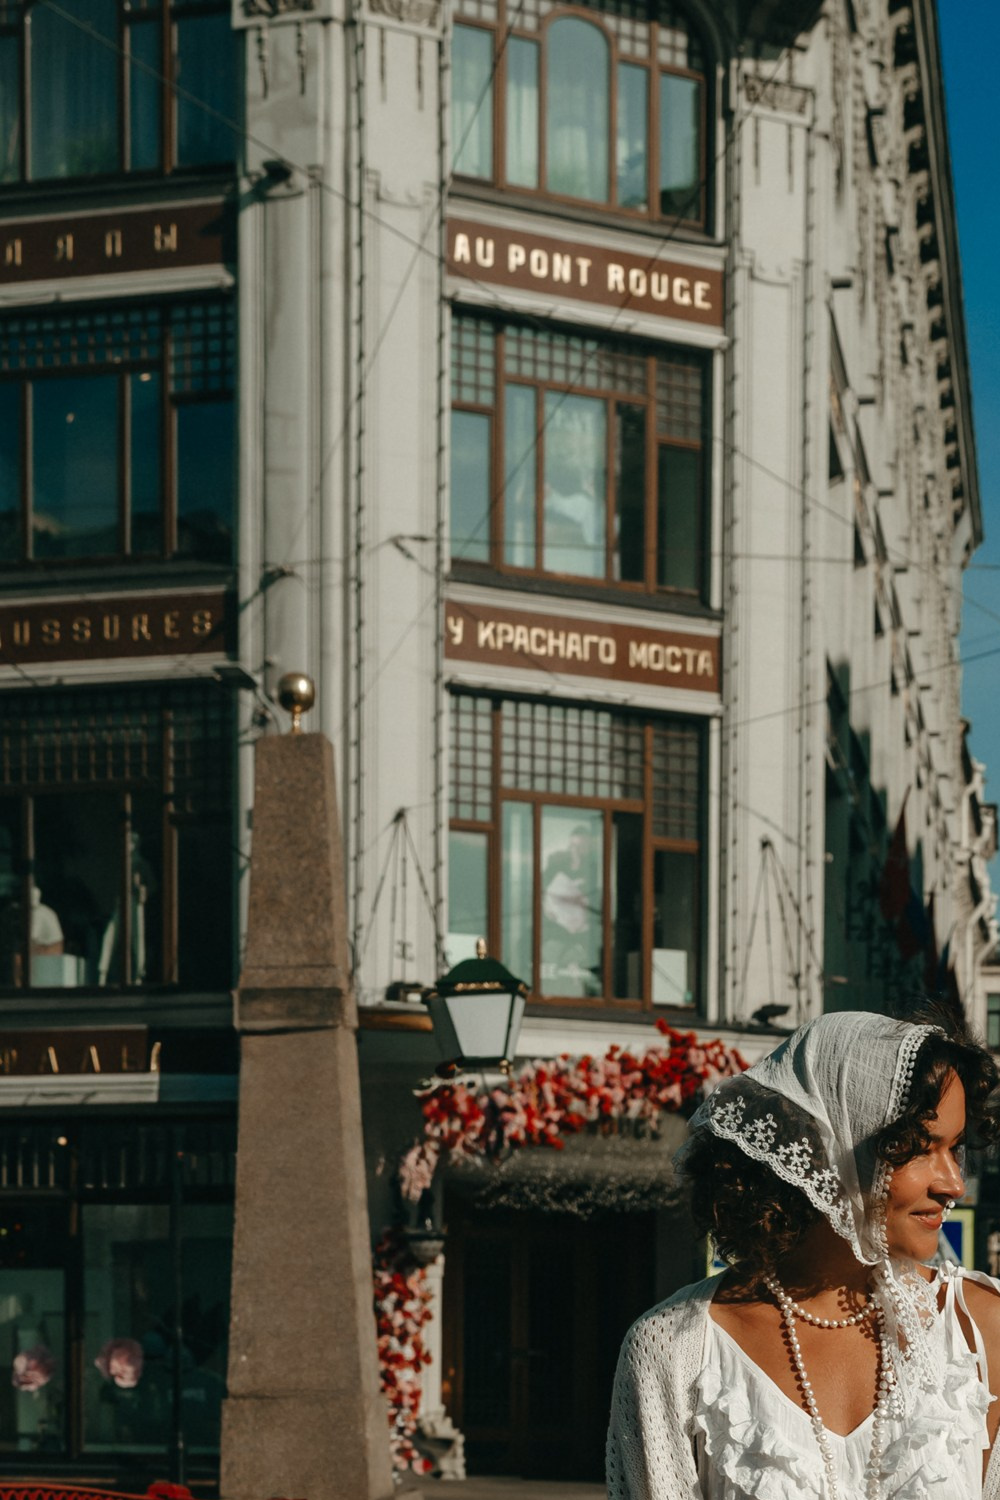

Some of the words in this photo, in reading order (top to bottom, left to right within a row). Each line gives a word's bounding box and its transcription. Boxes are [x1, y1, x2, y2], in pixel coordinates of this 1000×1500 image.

[454, 233, 495, 268] AU
[507, 243, 592, 287] PONT
[607, 263, 712, 310] ROUGE
[0, 610, 212, 647] USSURES
[447, 616, 464, 646] У
[477, 621, 617, 665] КРАСНАГО
[629, 640, 714, 678] МОСТА
